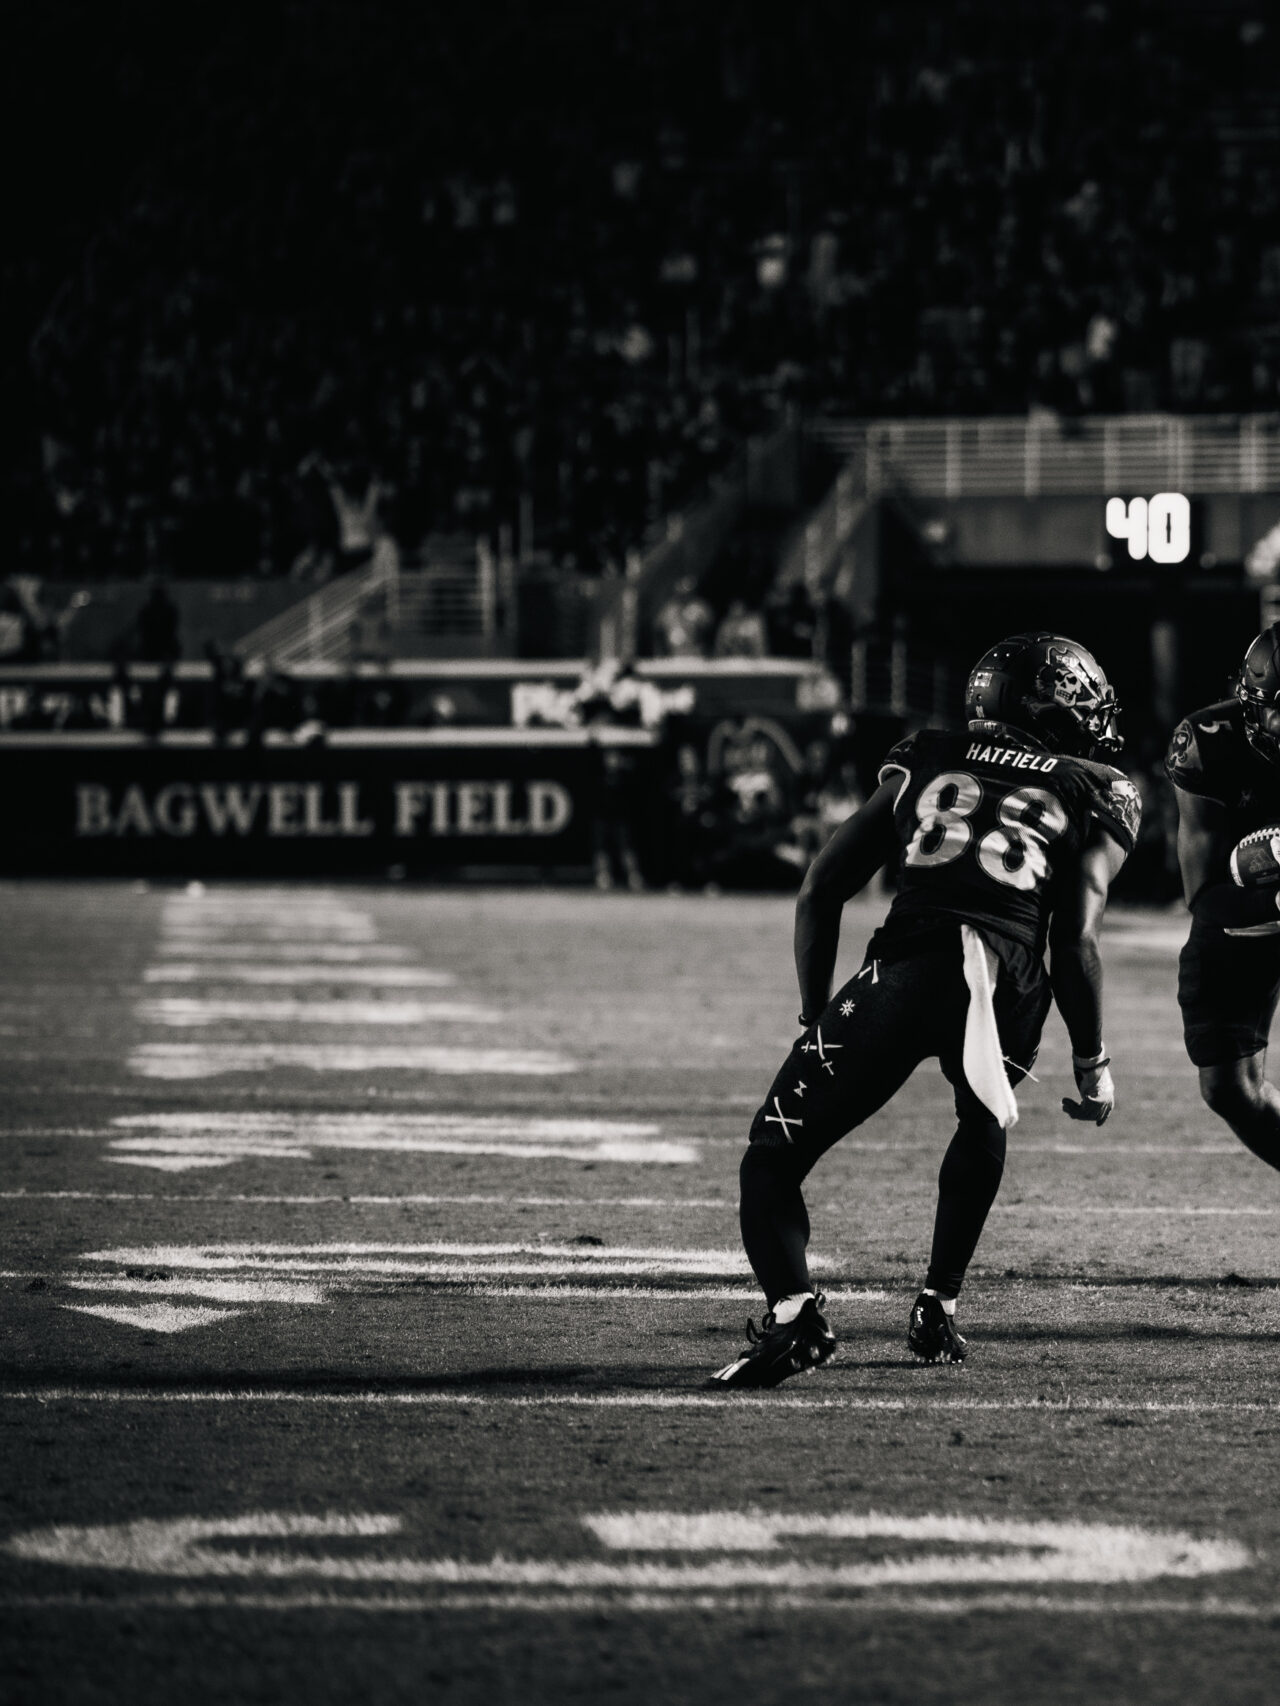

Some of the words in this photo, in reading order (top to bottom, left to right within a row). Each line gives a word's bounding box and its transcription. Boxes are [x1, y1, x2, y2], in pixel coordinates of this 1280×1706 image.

[1105, 492, 1191, 564] 40
[965, 742, 1059, 773] HATFIELD
[76, 781, 375, 837] BAGWELL
[394, 779, 574, 836] FIELD
[904, 770, 1069, 892] 88
